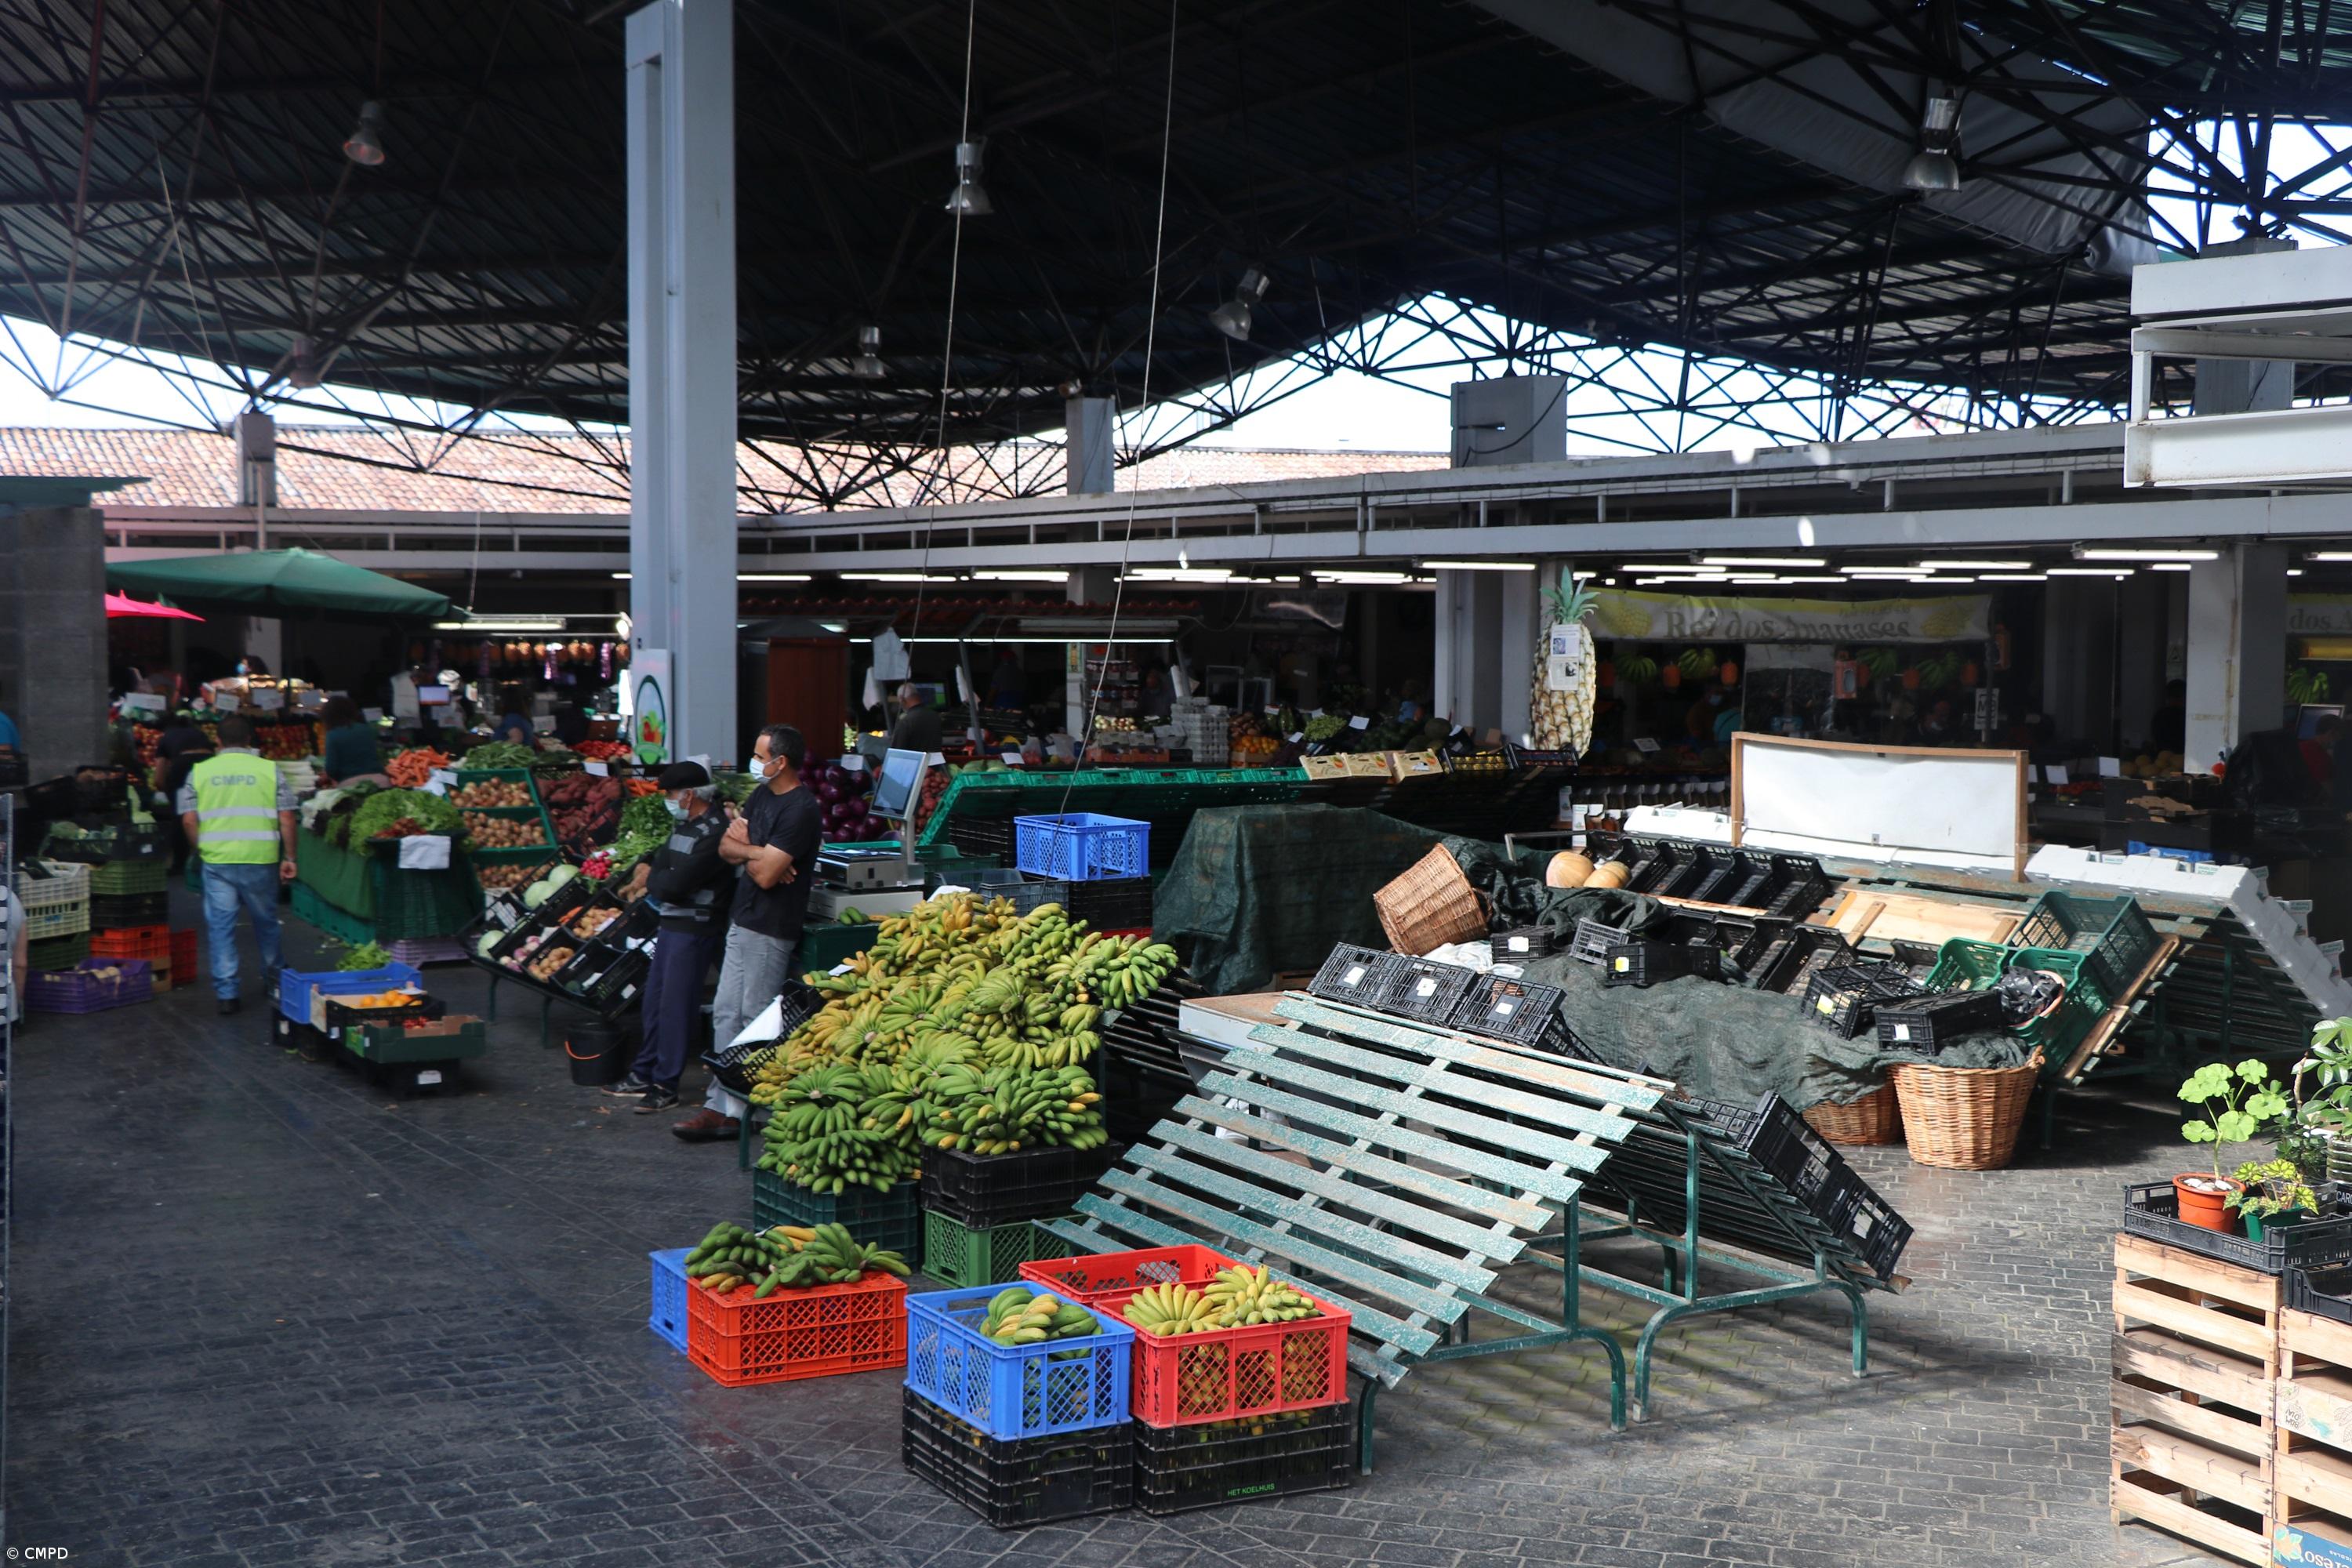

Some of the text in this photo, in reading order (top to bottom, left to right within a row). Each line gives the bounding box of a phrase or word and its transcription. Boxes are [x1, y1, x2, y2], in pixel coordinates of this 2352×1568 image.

[1726, 612, 1775, 639] dos
[2288, 608, 2332, 630] dos
[212, 775, 256, 786] CMPD
[1227, 1483, 1276, 1497] HET KOELHUIS
